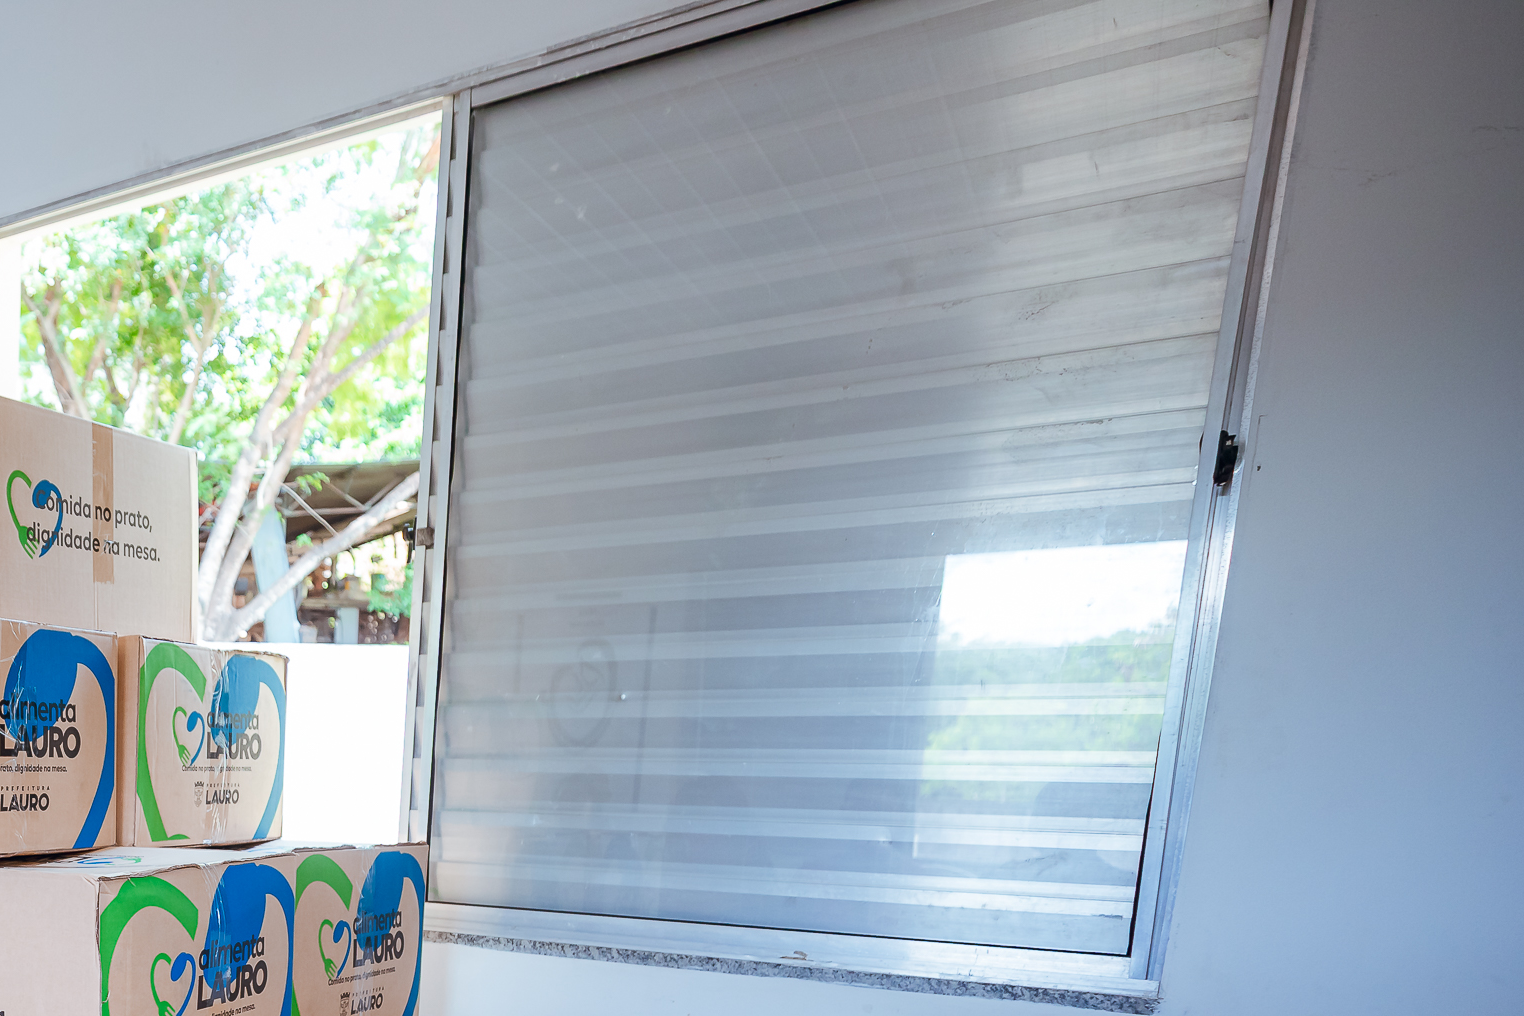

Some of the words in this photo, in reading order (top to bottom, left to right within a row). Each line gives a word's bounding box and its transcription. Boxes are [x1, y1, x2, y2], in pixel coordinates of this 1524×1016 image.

[36, 489, 91, 518] Comida
[95, 505, 111, 522] no
[115, 509, 152, 532] prato,
[27, 522, 100, 552] dignidade
[104, 539, 119, 555] na
[124, 541, 160, 562] mesa.
[0, 724, 81, 758] LAURO
[0, 793, 49, 812] LAURO
[198, 934, 264, 970] alimenta
[353, 930, 404, 968] LAURO
[197, 960, 268, 1010] LAURO
[350, 994, 383, 1016] LAURO
